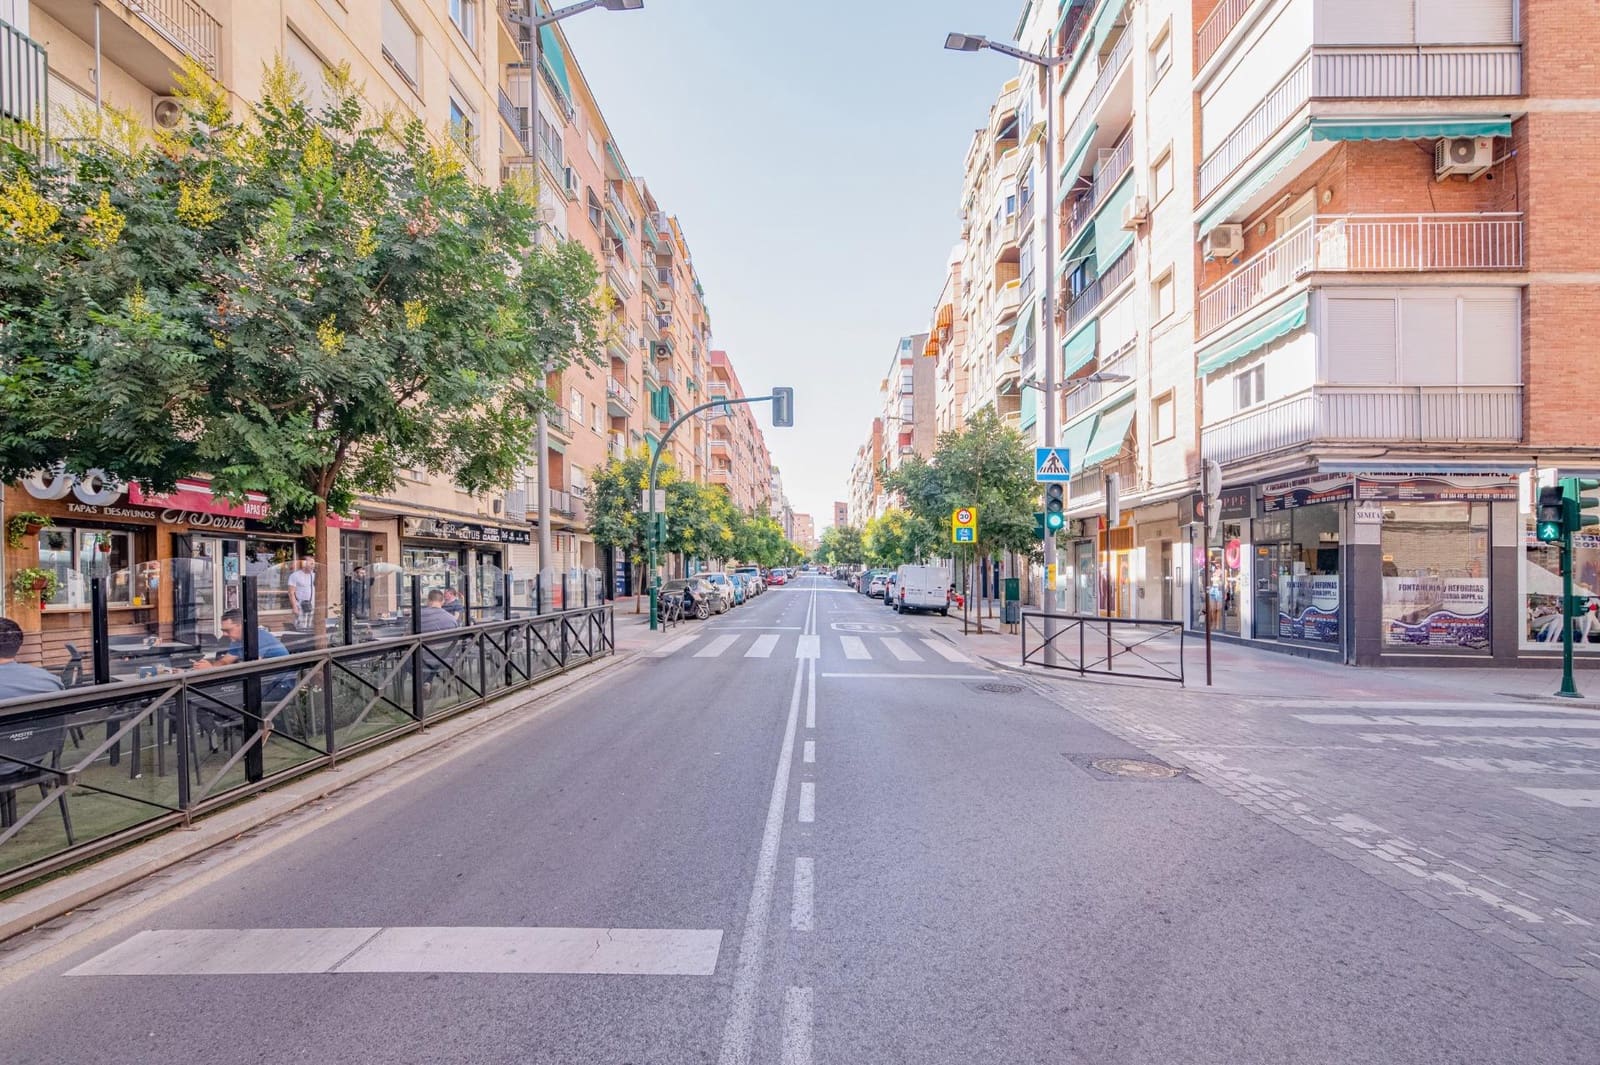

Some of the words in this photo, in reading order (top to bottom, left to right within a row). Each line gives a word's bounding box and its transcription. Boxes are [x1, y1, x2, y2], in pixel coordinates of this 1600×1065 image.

[67, 503, 97, 514] TAPAS
[104, 507, 155, 519] DESAYUNOS
[244, 503, 260, 515] TAPAS
[1448, 584, 1484, 592] REFORMAS
